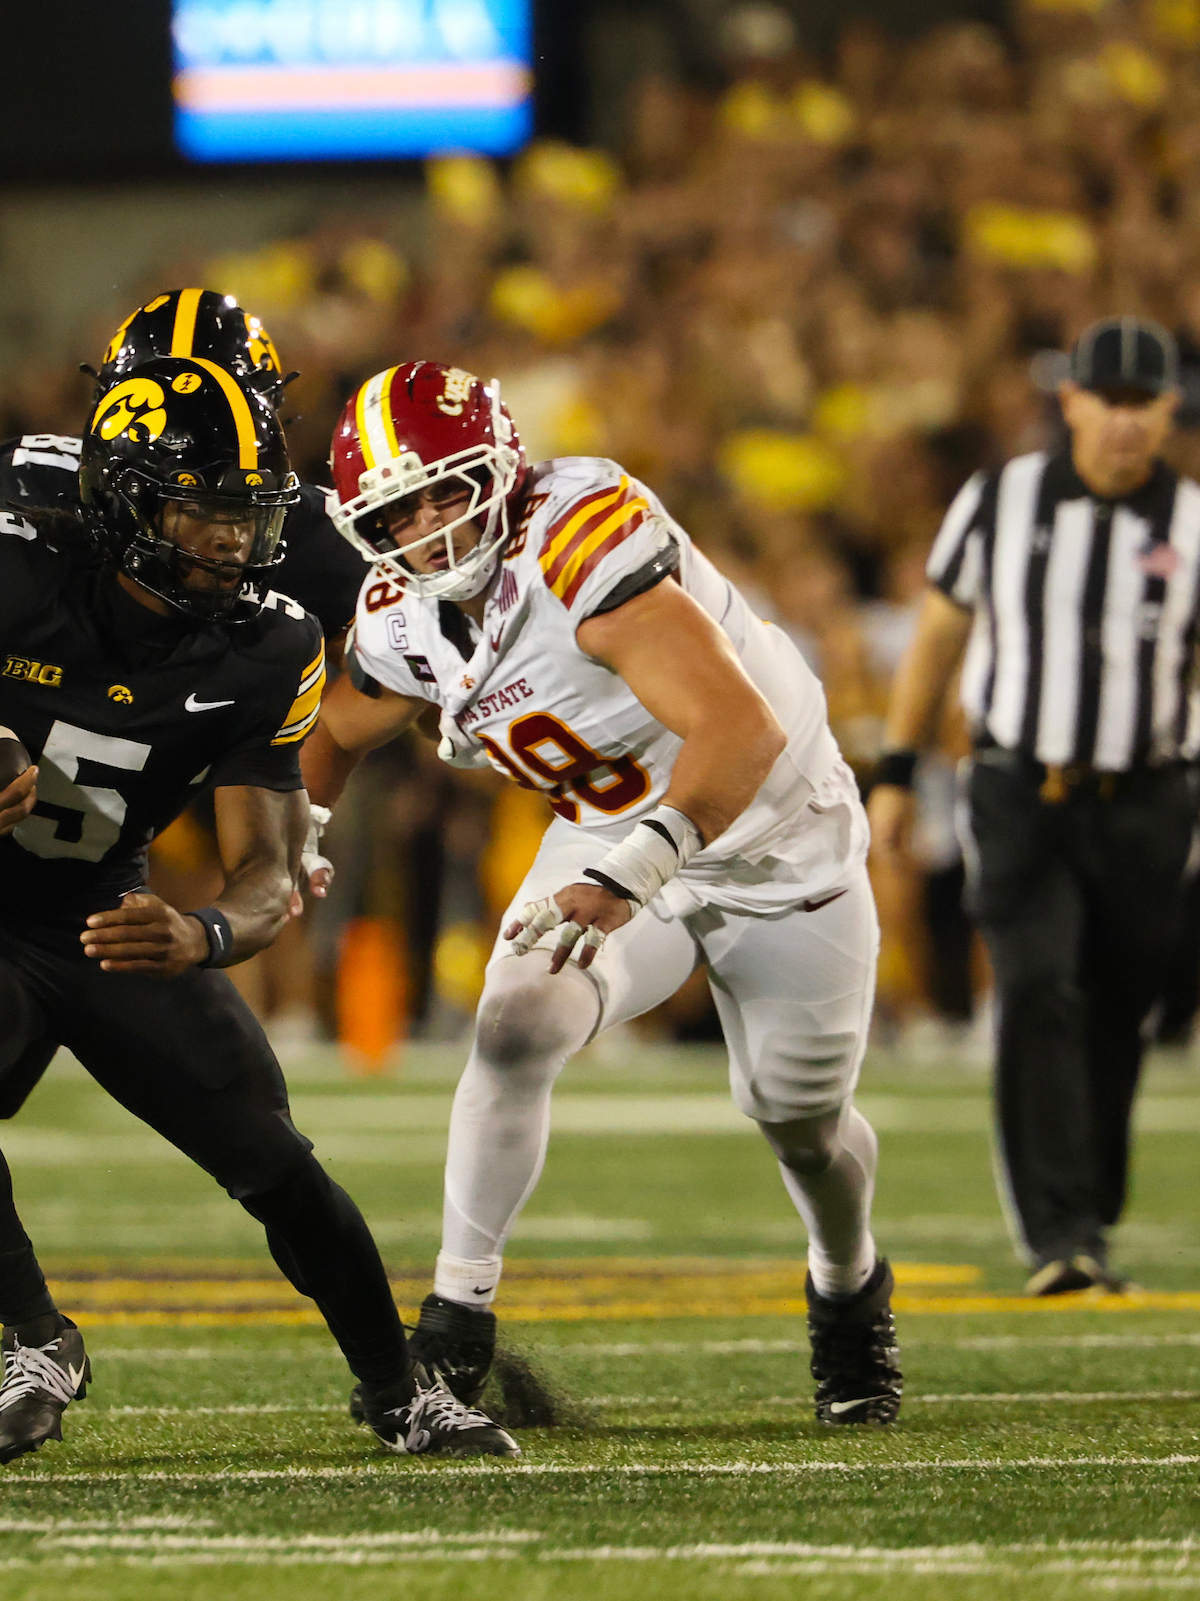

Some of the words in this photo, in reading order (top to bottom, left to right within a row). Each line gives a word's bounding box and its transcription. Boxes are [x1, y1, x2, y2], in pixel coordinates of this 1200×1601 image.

[386, 611, 409, 651] C
[477, 677, 534, 718] STATE
[12, 719, 152, 863] 5
